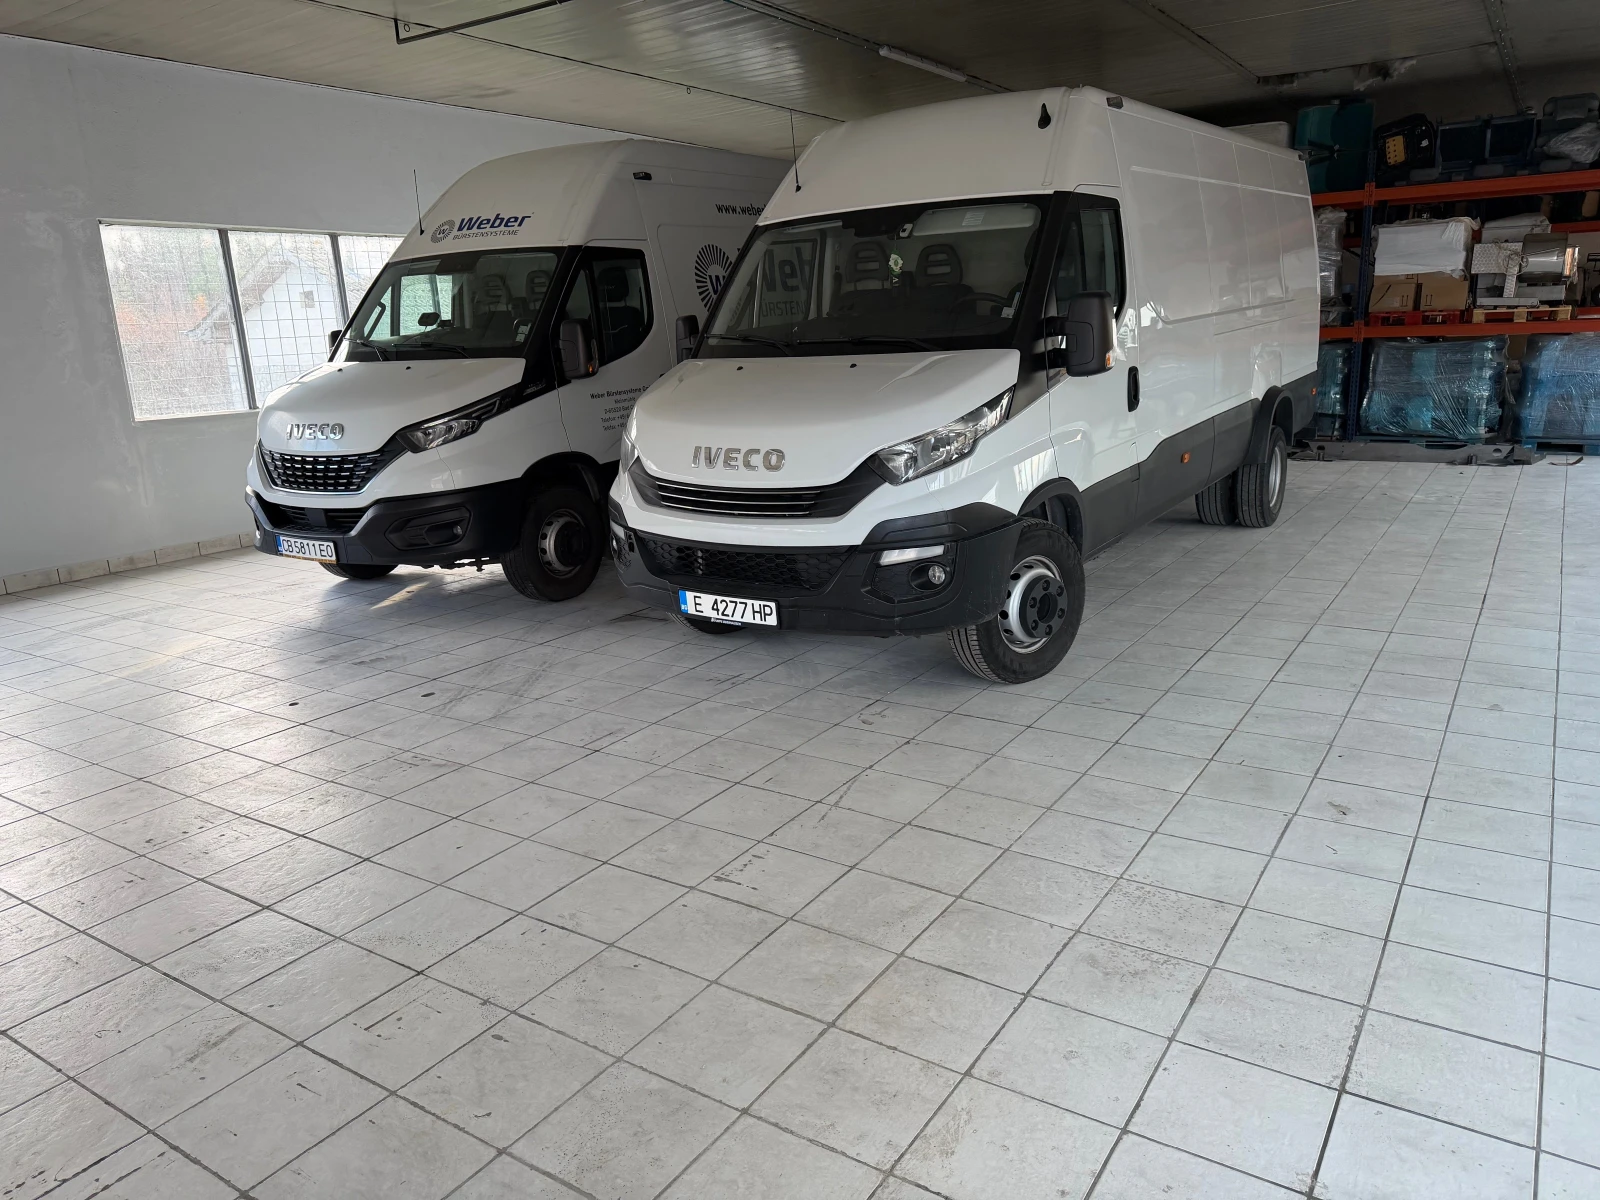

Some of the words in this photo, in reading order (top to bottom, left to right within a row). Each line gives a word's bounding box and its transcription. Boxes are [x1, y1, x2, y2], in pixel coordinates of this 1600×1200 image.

[457, 213, 531, 232] Weber
[453, 229, 519, 240] BÜRSTENSYSTEME
[287, 423, 344, 440] IVECO
[692, 446, 785, 472] IVECO
[694, 595, 703, 613] E
